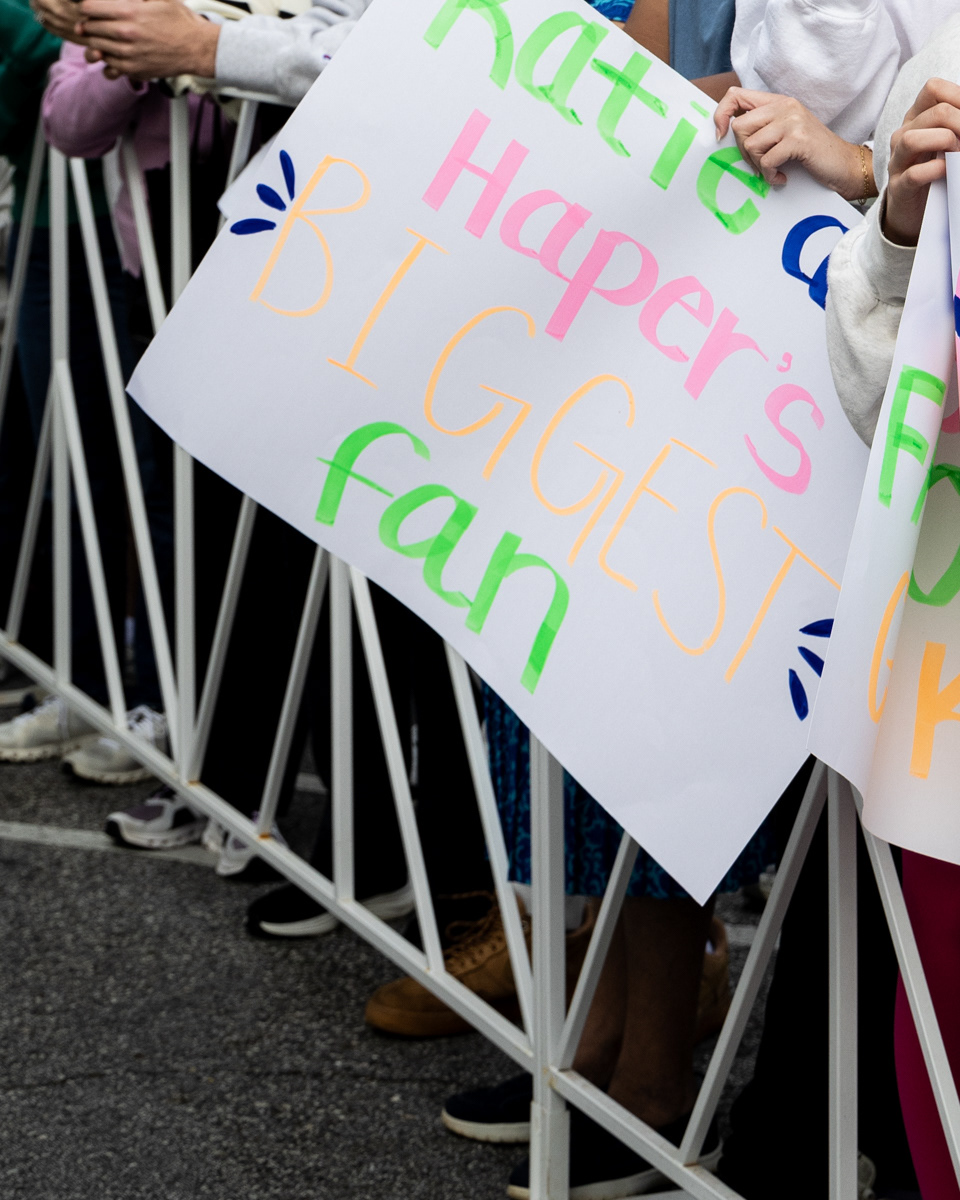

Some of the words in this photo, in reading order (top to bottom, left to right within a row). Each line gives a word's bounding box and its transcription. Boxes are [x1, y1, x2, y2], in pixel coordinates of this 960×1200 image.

[249, 154, 842, 683] BIGGEST
[421, 108, 825, 494] Haper's
[314, 420, 571, 696] fan
